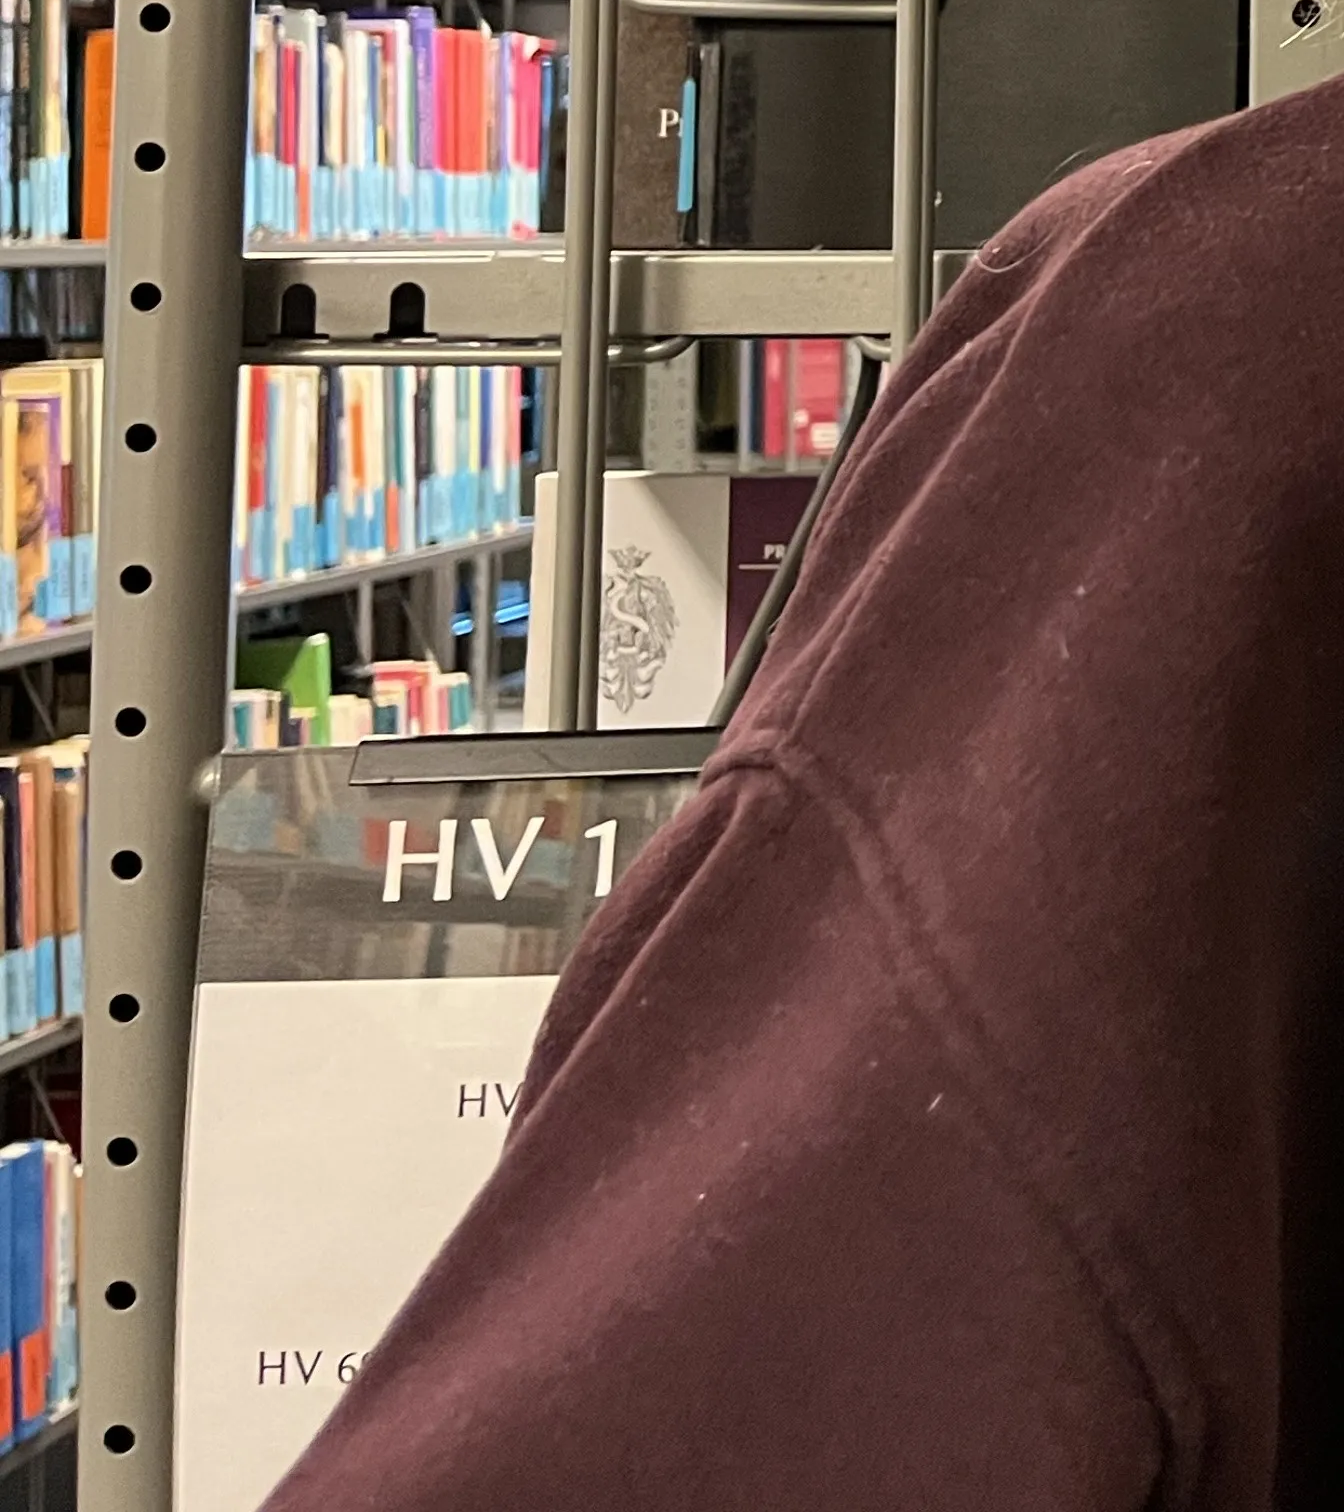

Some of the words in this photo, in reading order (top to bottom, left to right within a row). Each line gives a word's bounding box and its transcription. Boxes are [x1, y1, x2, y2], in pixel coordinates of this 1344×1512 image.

[382, 816, 546, 902] HV
[457, 1082, 524, 1118] HV
[258, 1350, 323, 1386] HV
[337, 1351, 372, 1385] 6
